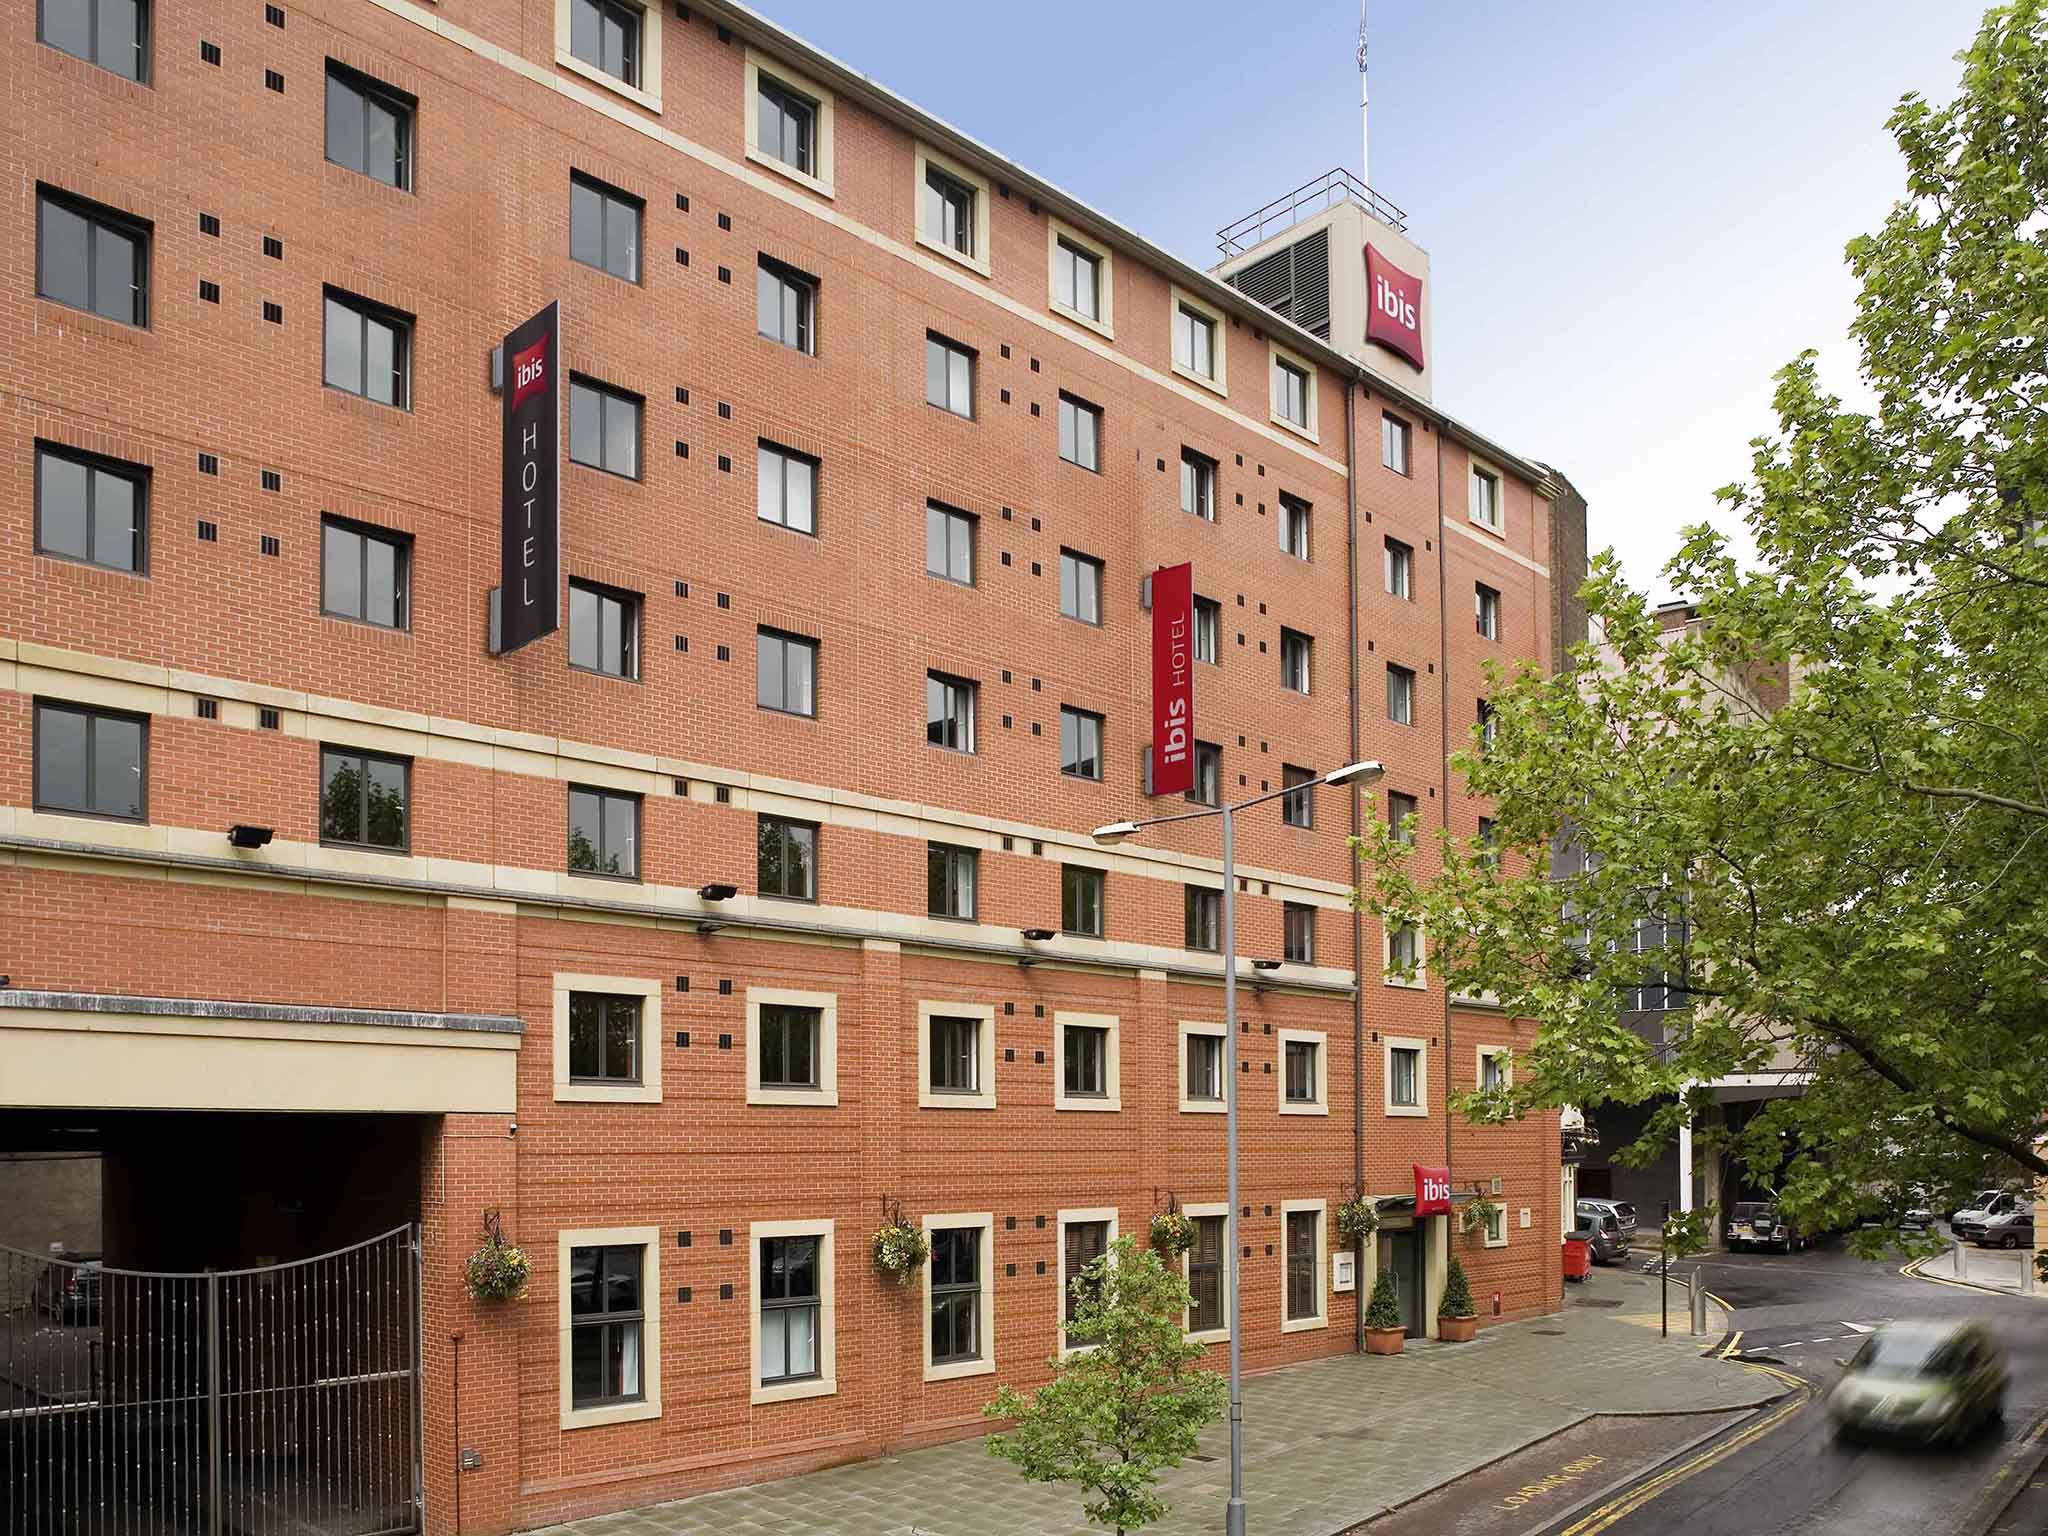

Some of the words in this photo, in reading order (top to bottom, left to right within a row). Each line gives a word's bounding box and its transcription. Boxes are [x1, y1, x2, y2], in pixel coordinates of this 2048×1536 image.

[1377, 274, 1416, 330] ibis
[518, 357, 543, 389] ibis
[522, 422, 537, 606] HOTEL
[1171, 611, 1186, 688] HOTEL
[1164, 697, 1187, 764] ibis
[1423, 1177, 1450, 1201] ibis
